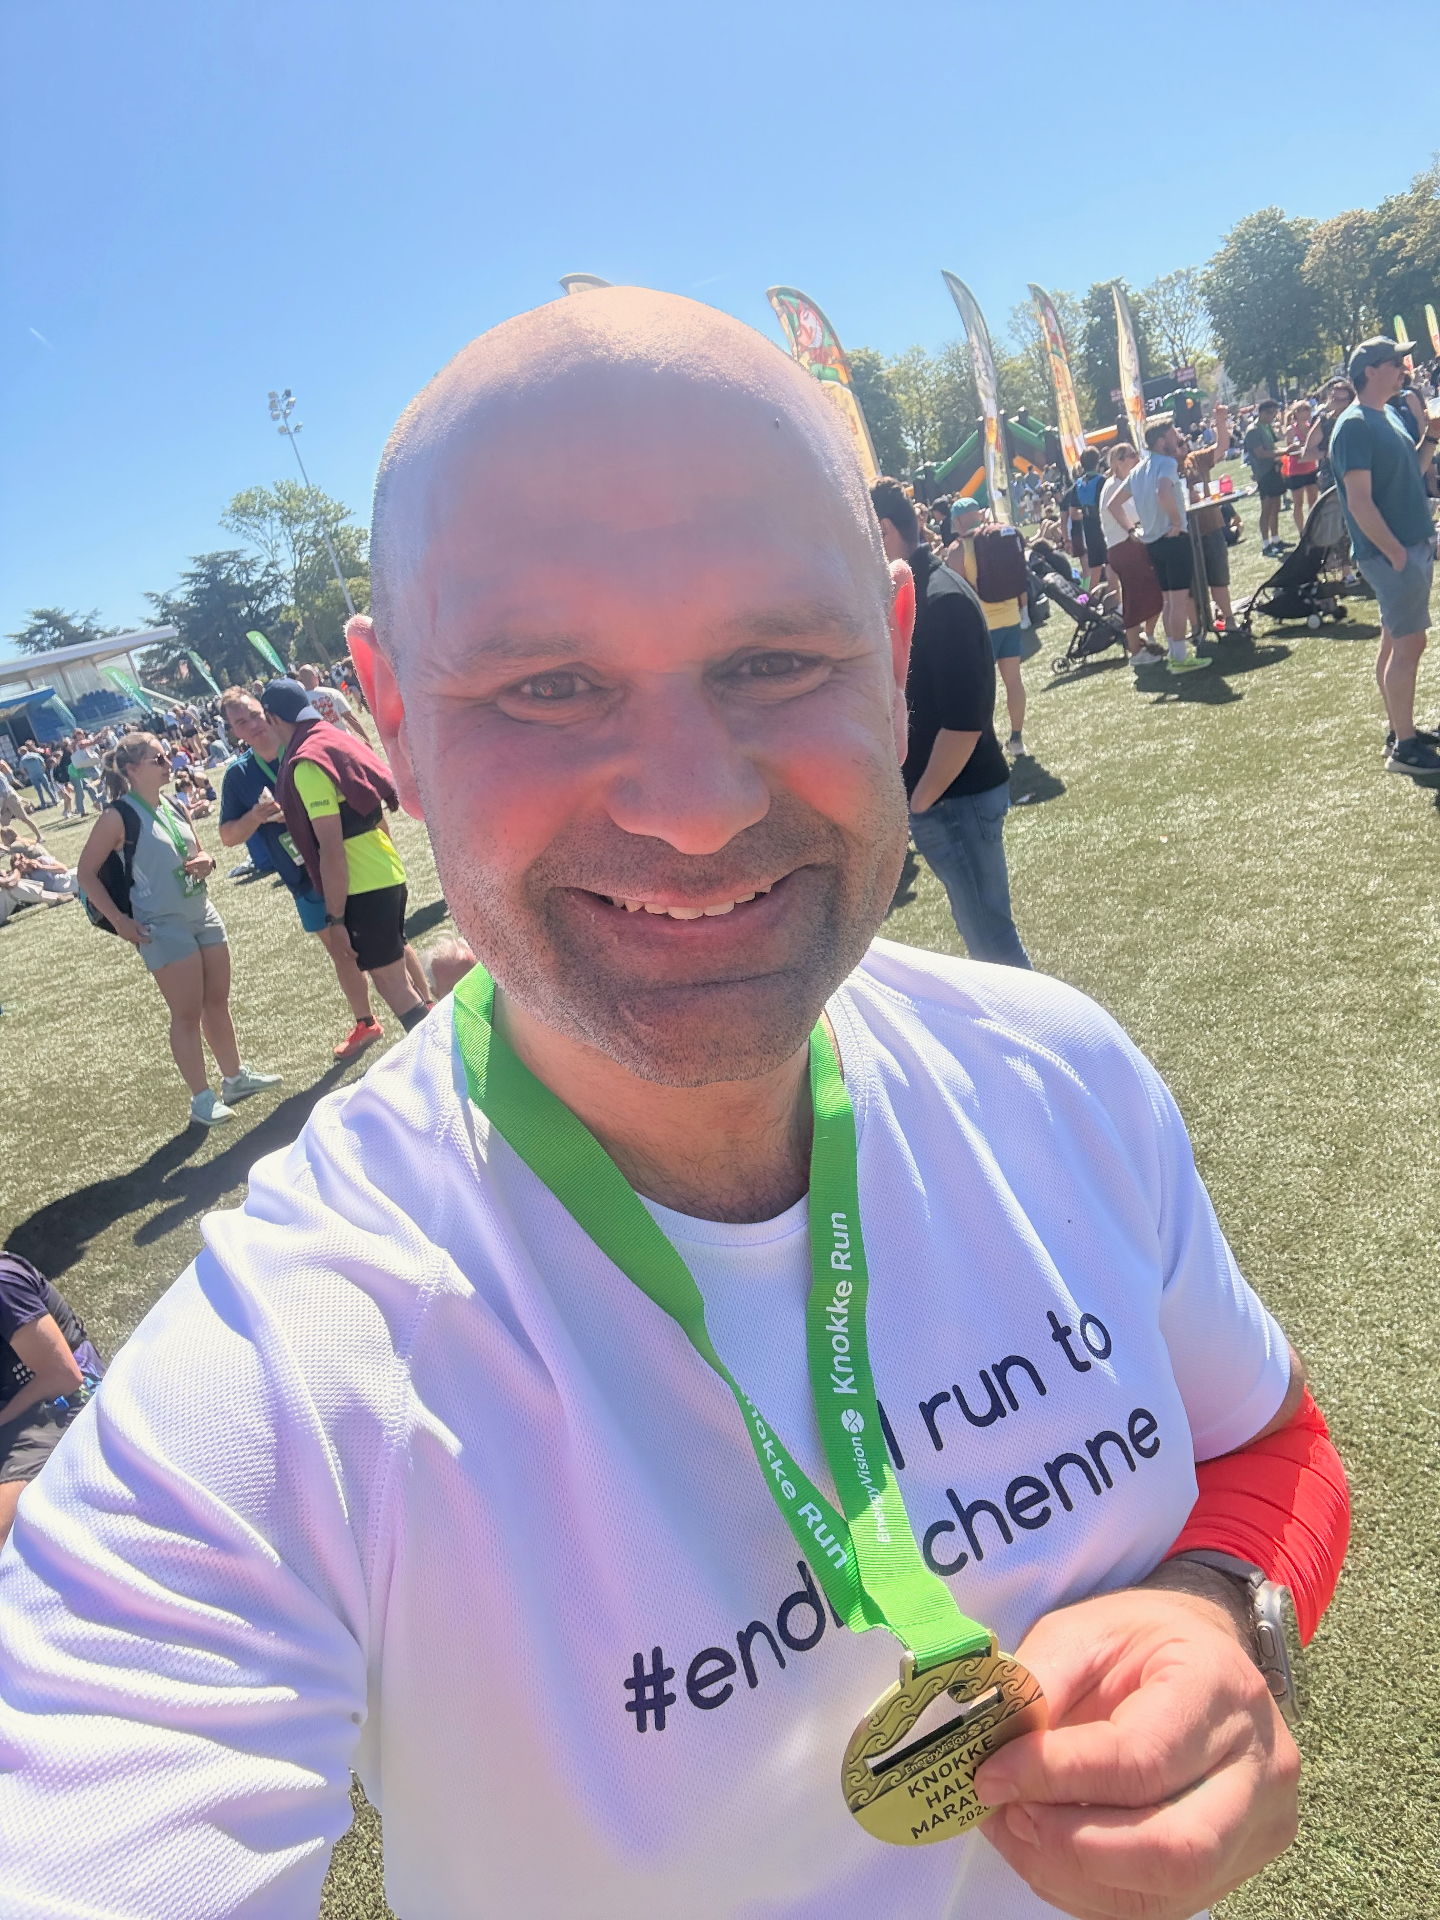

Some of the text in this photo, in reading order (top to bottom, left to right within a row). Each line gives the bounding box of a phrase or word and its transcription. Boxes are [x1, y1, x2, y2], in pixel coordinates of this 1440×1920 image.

[830, 1212, 852, 1270] Run
[825, 1280, 858, 1394] Knokke
[918, 1355, 1047, 1451] run
[1046, 1310, 1112, 1373] to
[742, 1391, 848, 1570] nokke Run
[623, 1407, 1160, 1734] #endchenne
[904, 1732, 968, 1775] EnergyVision
[907, 1734, 996, 1799] KNOKKE
[910, 1789, 979, 1840] MARAT
[925, 1766, 977, 1809] HALV
[957, 1805, 990, 1827] 202
